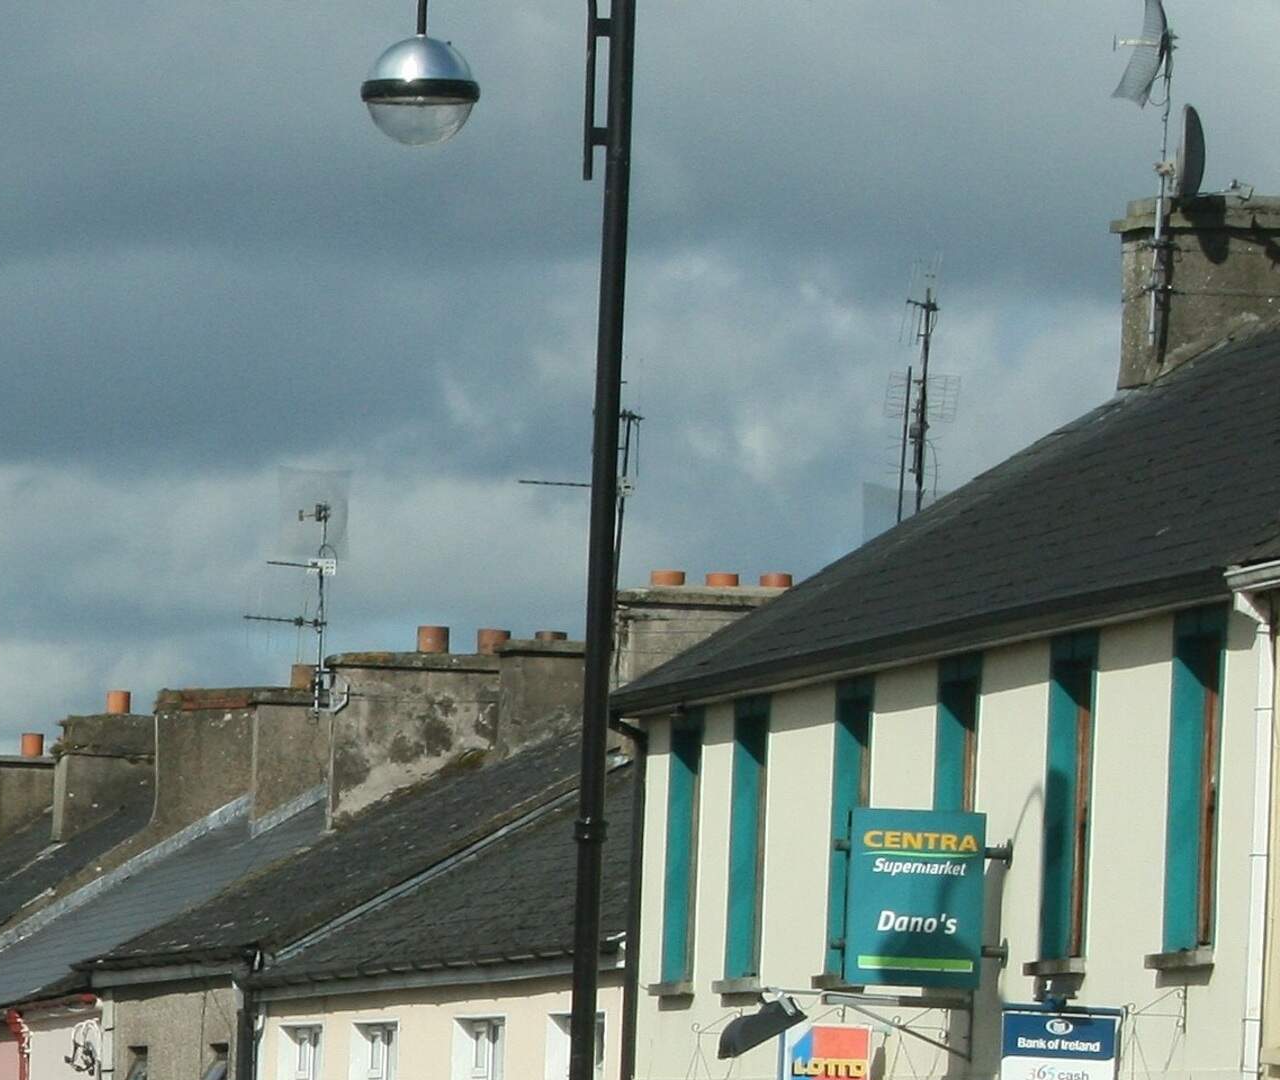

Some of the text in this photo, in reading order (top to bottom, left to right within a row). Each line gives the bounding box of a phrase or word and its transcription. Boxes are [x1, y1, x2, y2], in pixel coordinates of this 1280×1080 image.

[863, 830, 979, 852] CENTRA
[872, 857, 967, 876] Supermarket
[877, 909, 959, 935] Dano's
[1017, 1036, 1101, 1052] Bank of Ireland
[792, 1057, 867, 1078] LOTTO
